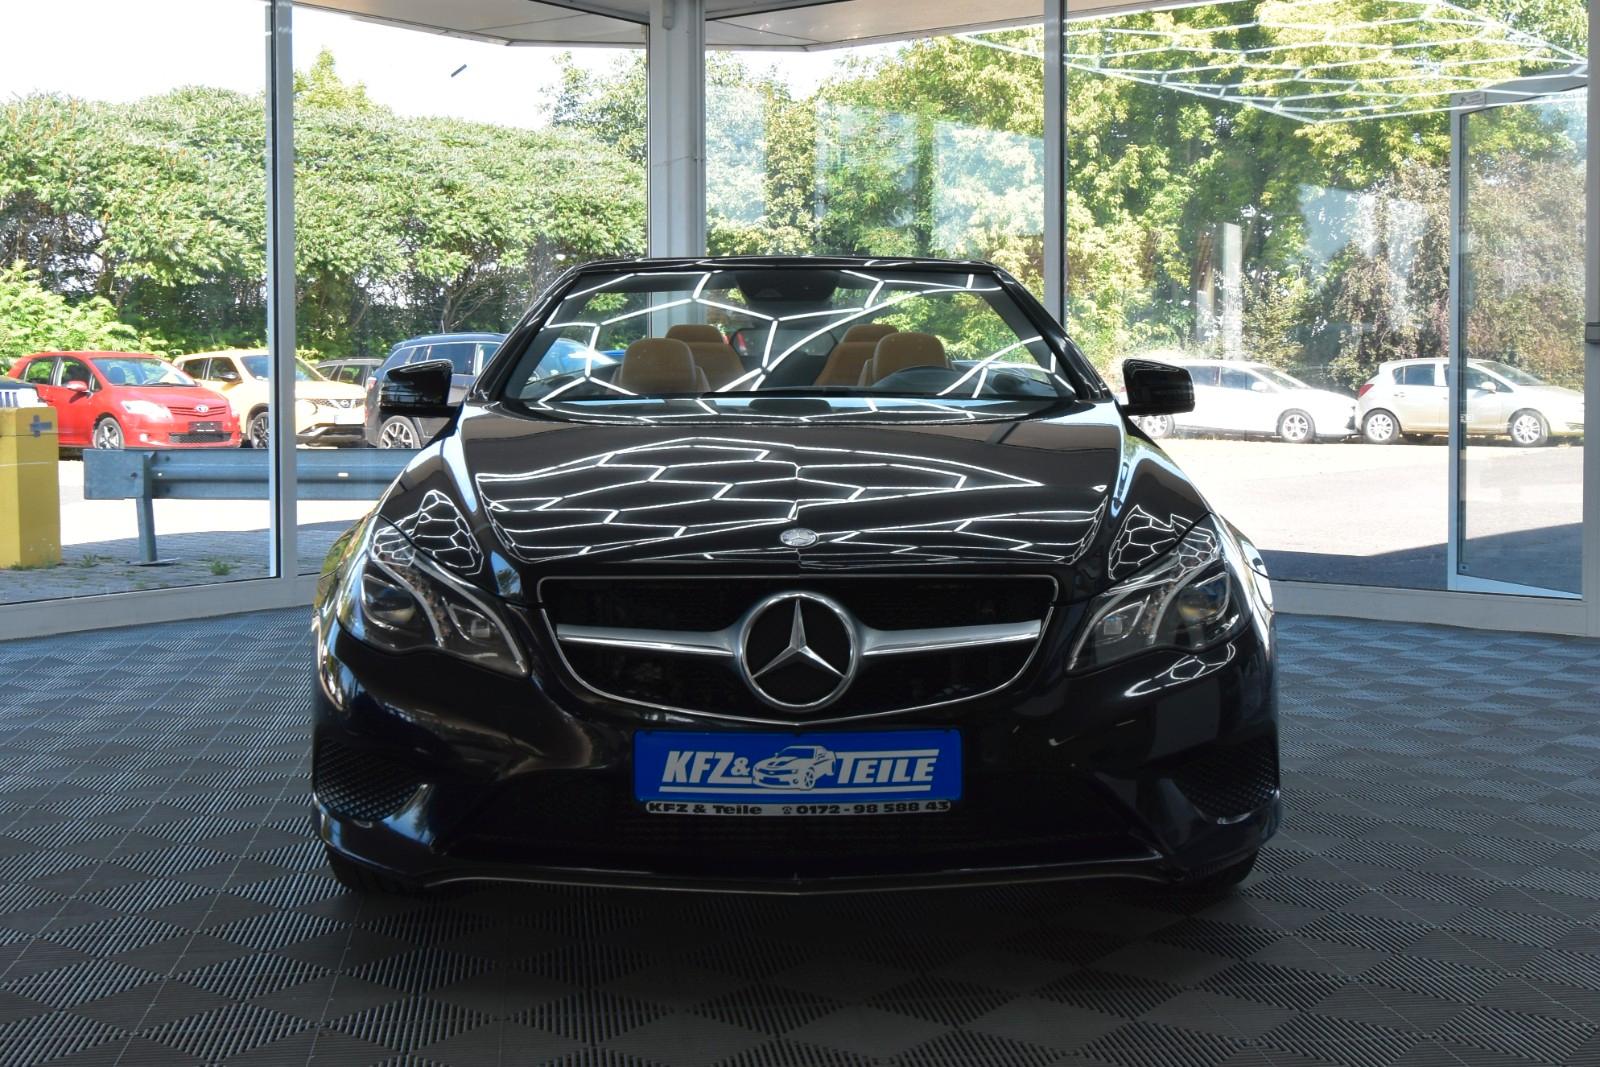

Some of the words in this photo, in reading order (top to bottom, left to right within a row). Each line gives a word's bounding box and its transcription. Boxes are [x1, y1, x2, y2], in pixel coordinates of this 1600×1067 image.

[836, 749, 939, 784] TEILE
[648, 802, 688, 813] KFZ
[693, 804, 706, 814] &
[713, 804, 762, 815] Teile
[925, 801, 949, 811] 43
